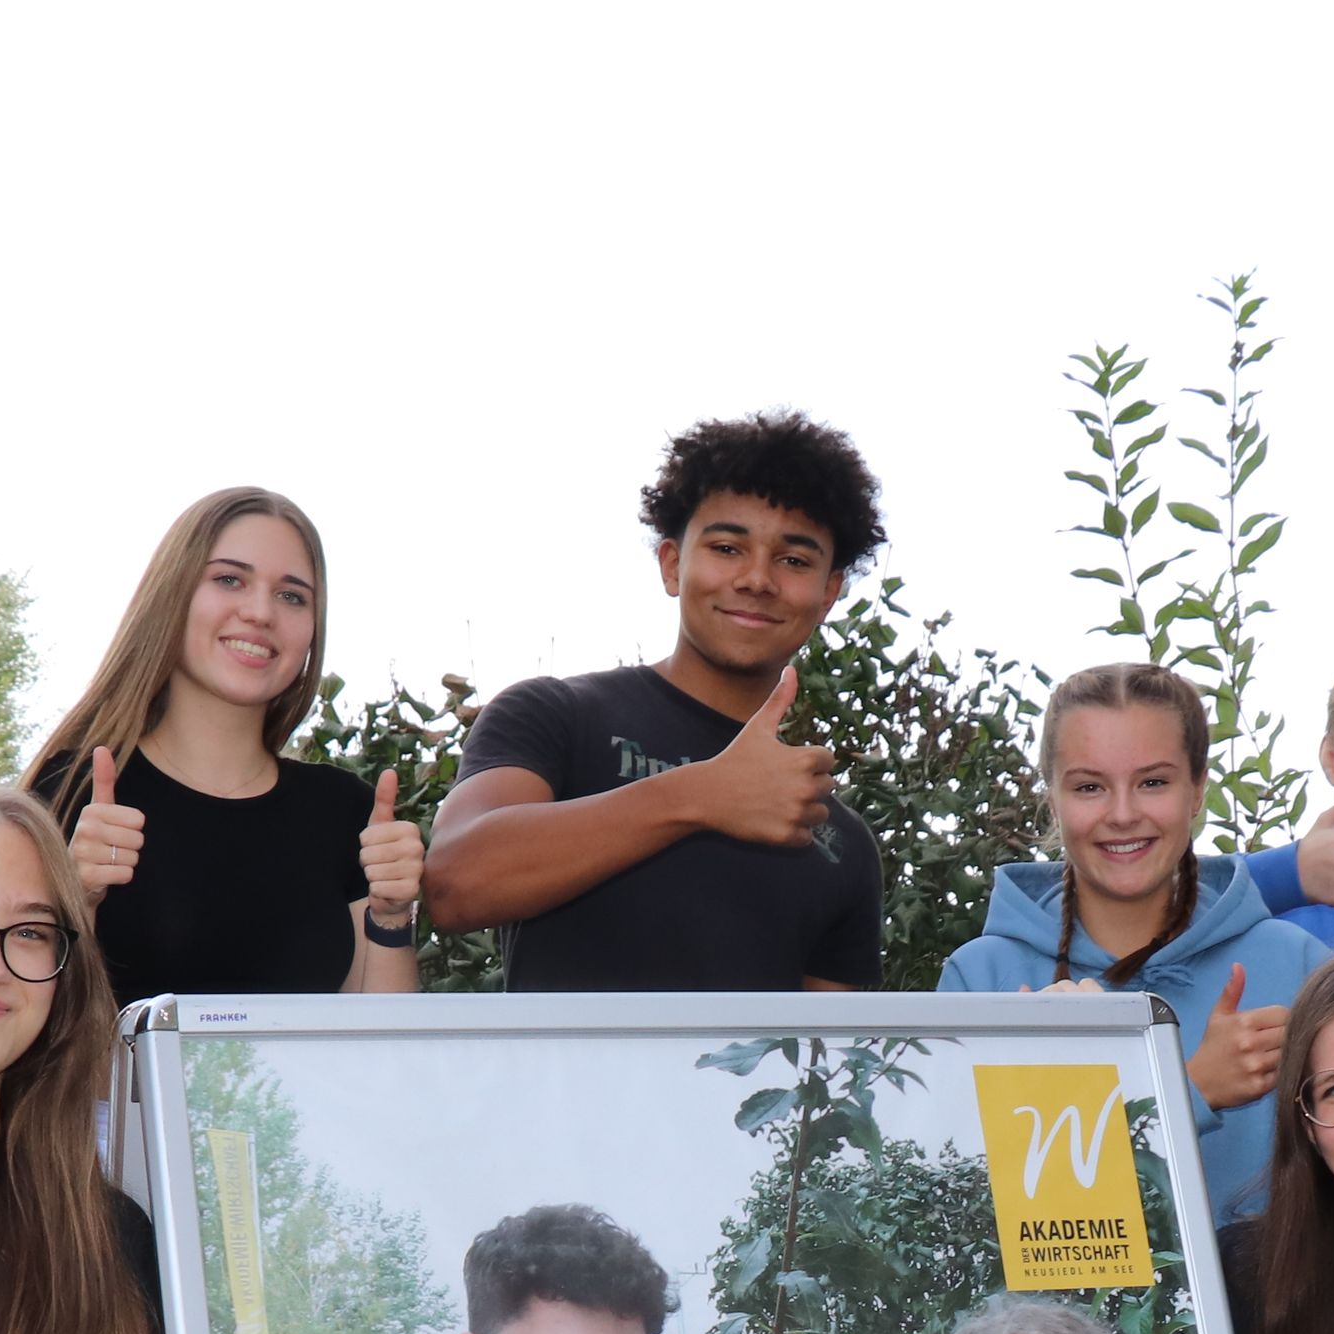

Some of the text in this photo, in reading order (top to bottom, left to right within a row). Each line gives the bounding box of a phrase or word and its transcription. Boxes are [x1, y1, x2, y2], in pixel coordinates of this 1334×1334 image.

[199, 1012, 247, 1022] FRANKEN
[1020, 1219, 1127, 1241] AKADEMIE
[1021, 1245, 1129, 1263] DER WIRTSCHAFT
[1024, 1264, 1134, 1277] NEUSIEDL AM SEE
